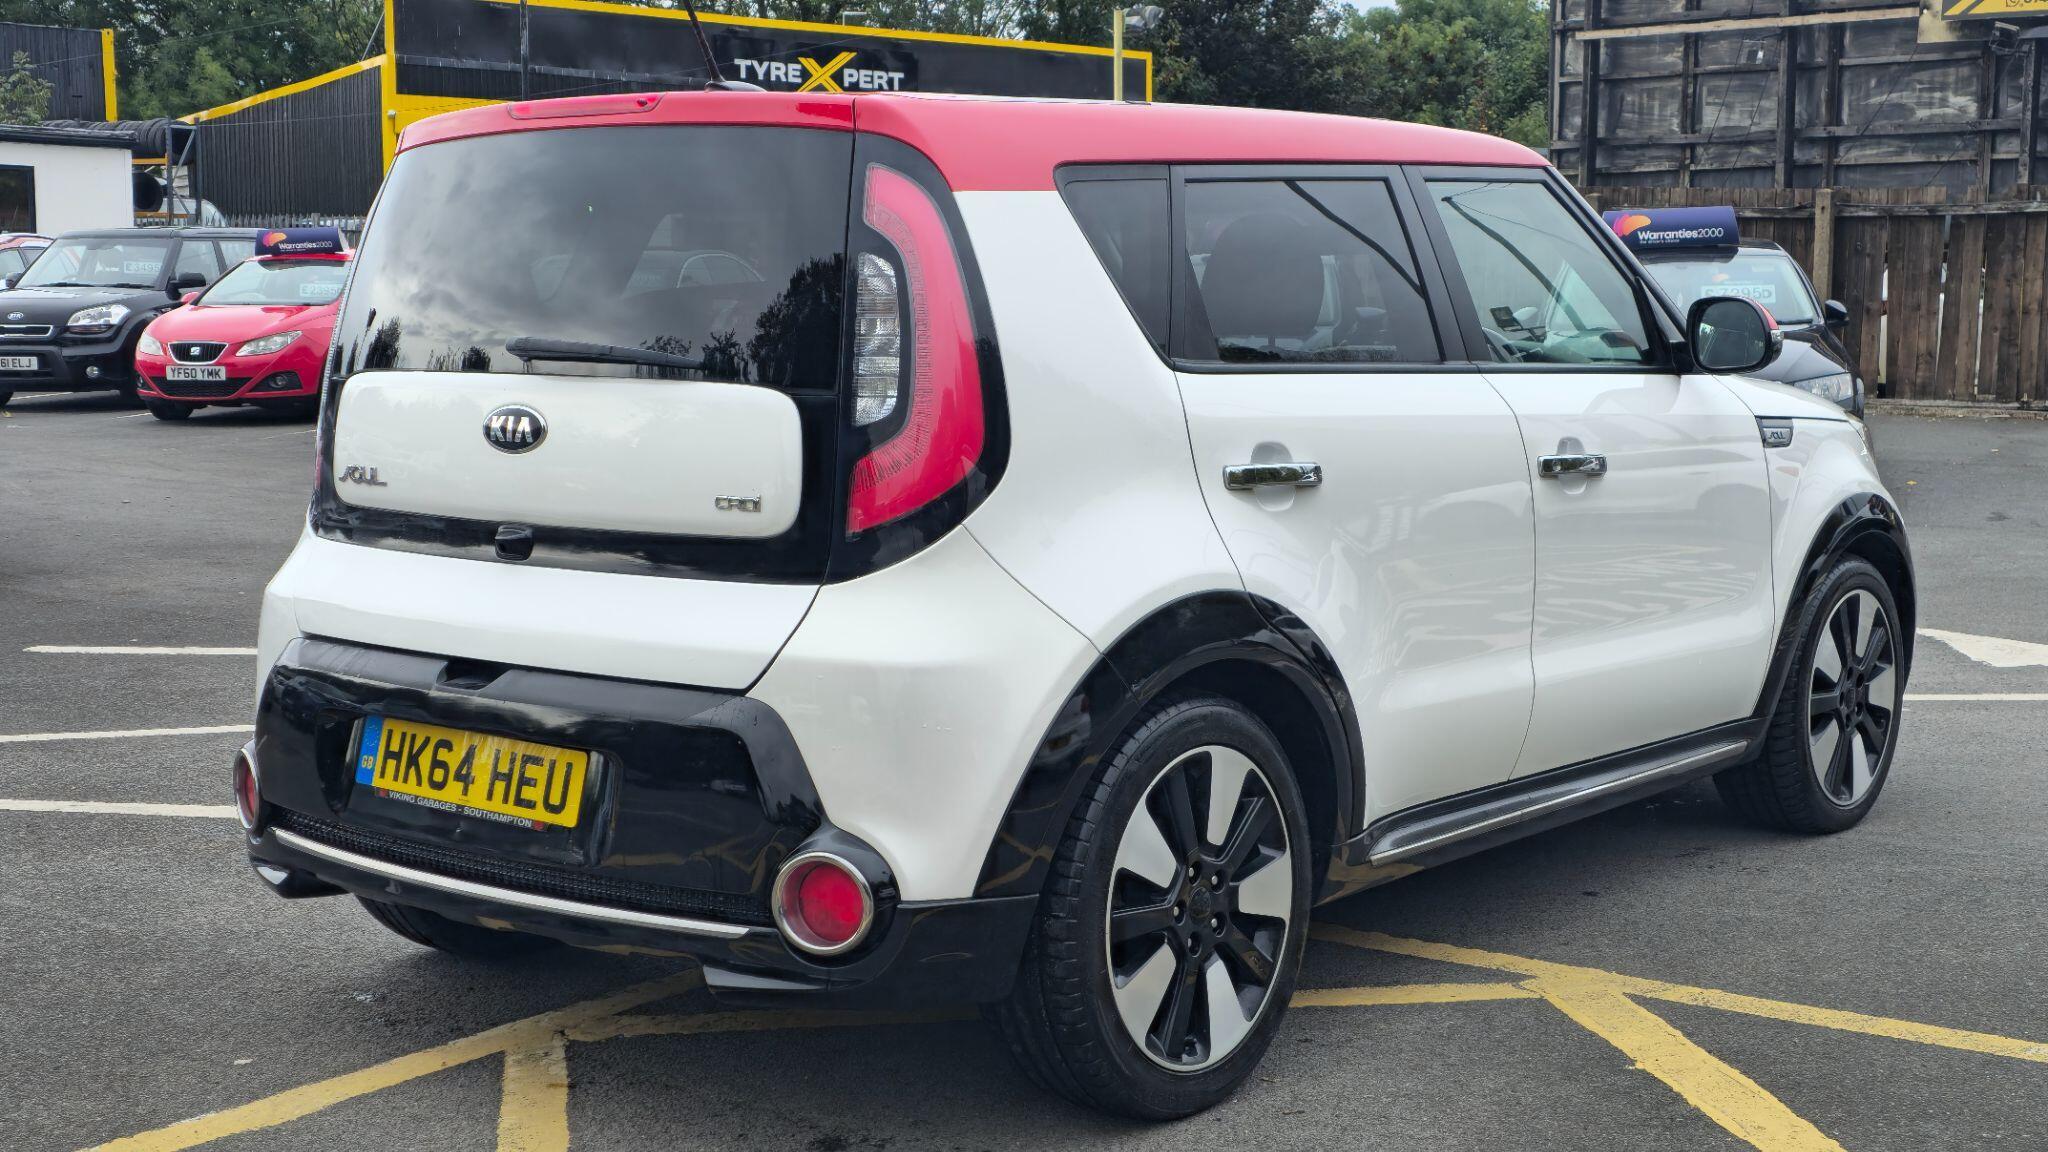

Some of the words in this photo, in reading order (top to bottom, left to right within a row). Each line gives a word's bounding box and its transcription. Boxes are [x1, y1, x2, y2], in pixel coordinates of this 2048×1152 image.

[1637, 227, 1724, 240] Warranties2000
[170, 366, 197, 379] YF60
[199, 366, 221, 380] YMK
[490, 415, 533, 443] KIA
[378, 728, 478, 797] HK64
[485, 748, 573, 815] HEU
[388, 790, 416, 805] VIKING
[417, 796, 457, 812] GARAGES
[463, 806, 532, 828] SOUTHAMPTON
